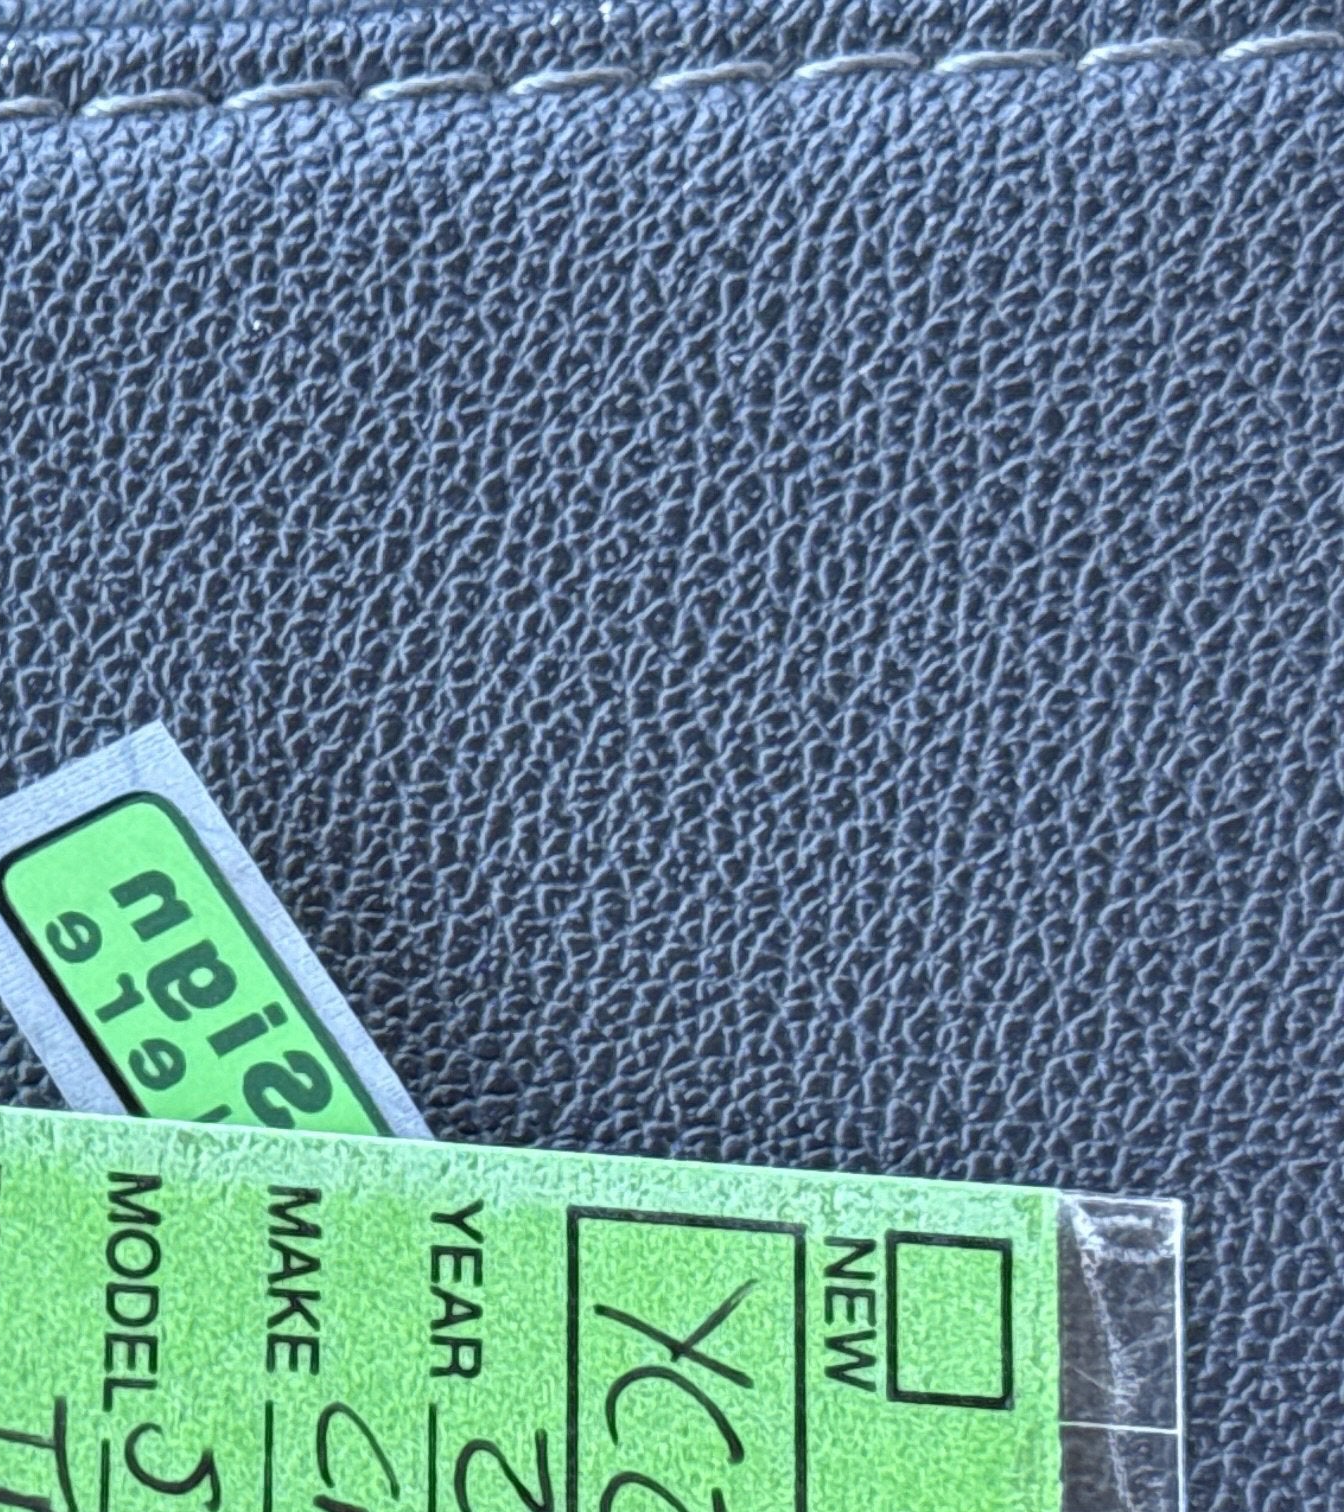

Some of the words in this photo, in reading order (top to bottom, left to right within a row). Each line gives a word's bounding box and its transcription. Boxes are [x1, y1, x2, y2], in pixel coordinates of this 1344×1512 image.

[102, 1171, 163, 1412] MODEL
[266, 1184, 322, 1375] MAKE
[429, 1198, 484, 1379] YEAR
[823, 1235, 876, 1392] NEW
